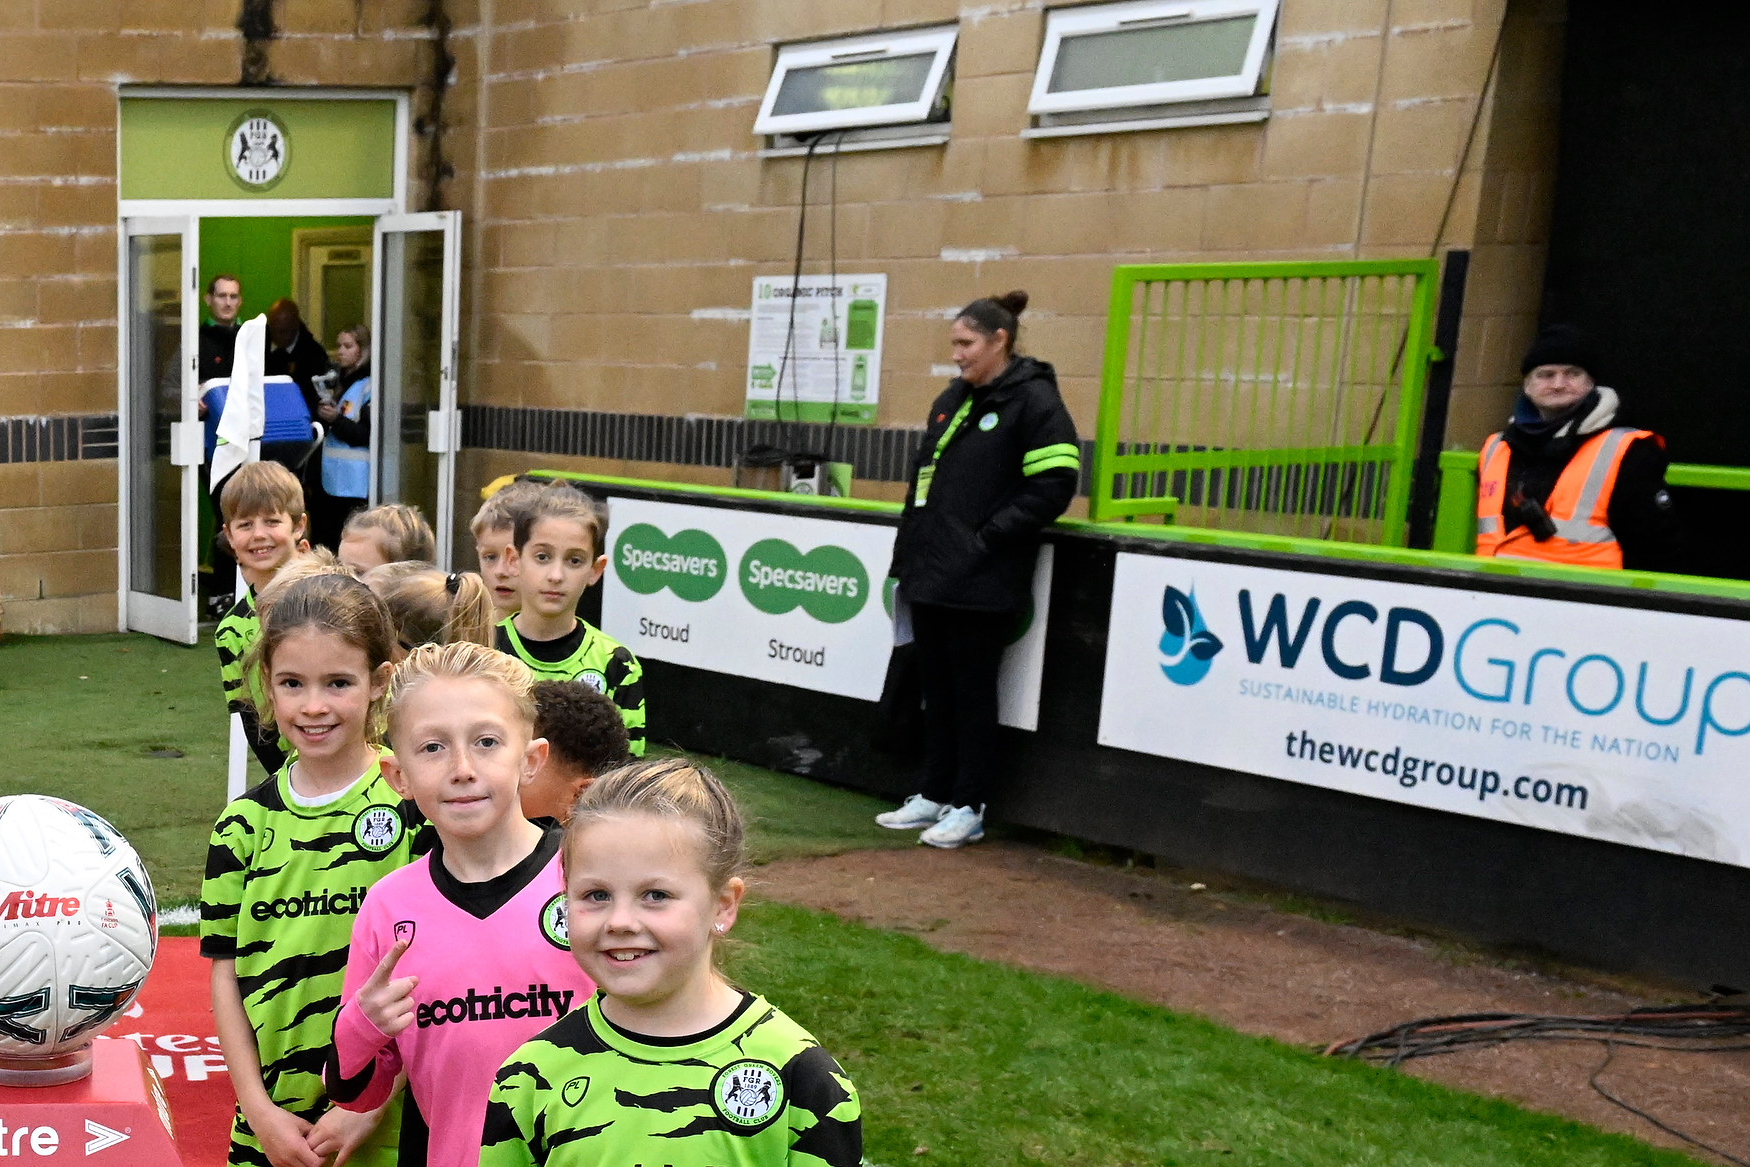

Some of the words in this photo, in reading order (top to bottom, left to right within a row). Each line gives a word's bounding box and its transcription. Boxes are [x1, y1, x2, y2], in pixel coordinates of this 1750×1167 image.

[621, 544, 719, 578] Specsavers
[748, 559, 860, 598] Specsavers
[638, 617, 691, 643] Stroud
[767, 638, 826, 667] Stroud
[1238, 679, 1361, 713] SUSTAINABLE
[1366, 699, 1483, 732] HYDRATION
[1490, 718, 1532, 742] FOR
[1541, 725, 1582, 749] THE
[1590, 734, 1680, 763] NATION
[1285, 730, 1589, 810] thewcdgroup.com
[250, 886, 368, 922] ecotricit
[397, 924, 408, 934] PL
[416, 983, 575, 1029] ecotricity
[566, 1081, 580, 1091] PL
[743, 1076, 761, 1085] FGR
